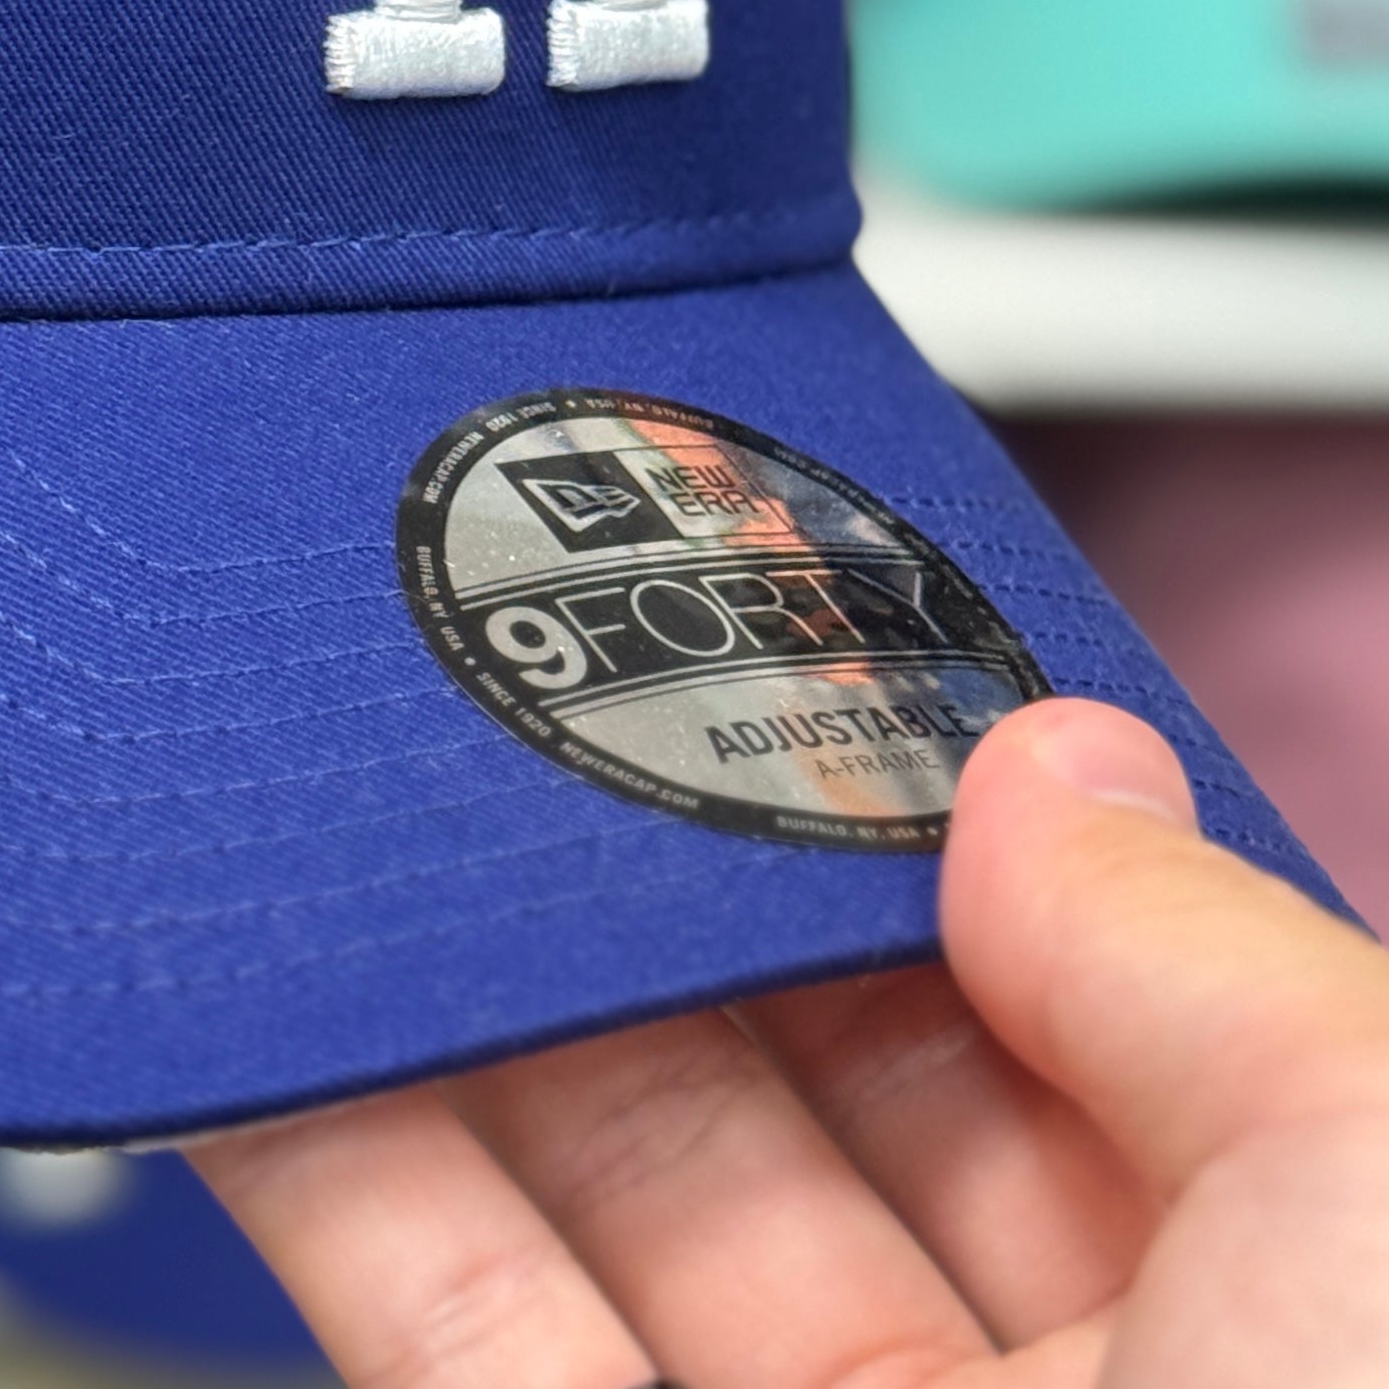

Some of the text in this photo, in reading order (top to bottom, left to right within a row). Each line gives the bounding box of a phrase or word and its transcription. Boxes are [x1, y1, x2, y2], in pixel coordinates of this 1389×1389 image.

[422, 431, 485, 504] NEWERACAP.COM
[644, 465, 735, 491] NEW
[668, 490, 760, 516] ERA
[485, 569, 948, 690] 9FORTY
[440, 626, 465, 652] USA
[476, 671, 517, 707] SINCE
[514, 707, 552, 738] 1920
[560, 741, 700, 809] NEWERACAP.COM
[705, 704, 981, 765] ADJUSTABLE
[814, 749, 940, 780] A-FRAME
[887, 825, 921, 840] USA
